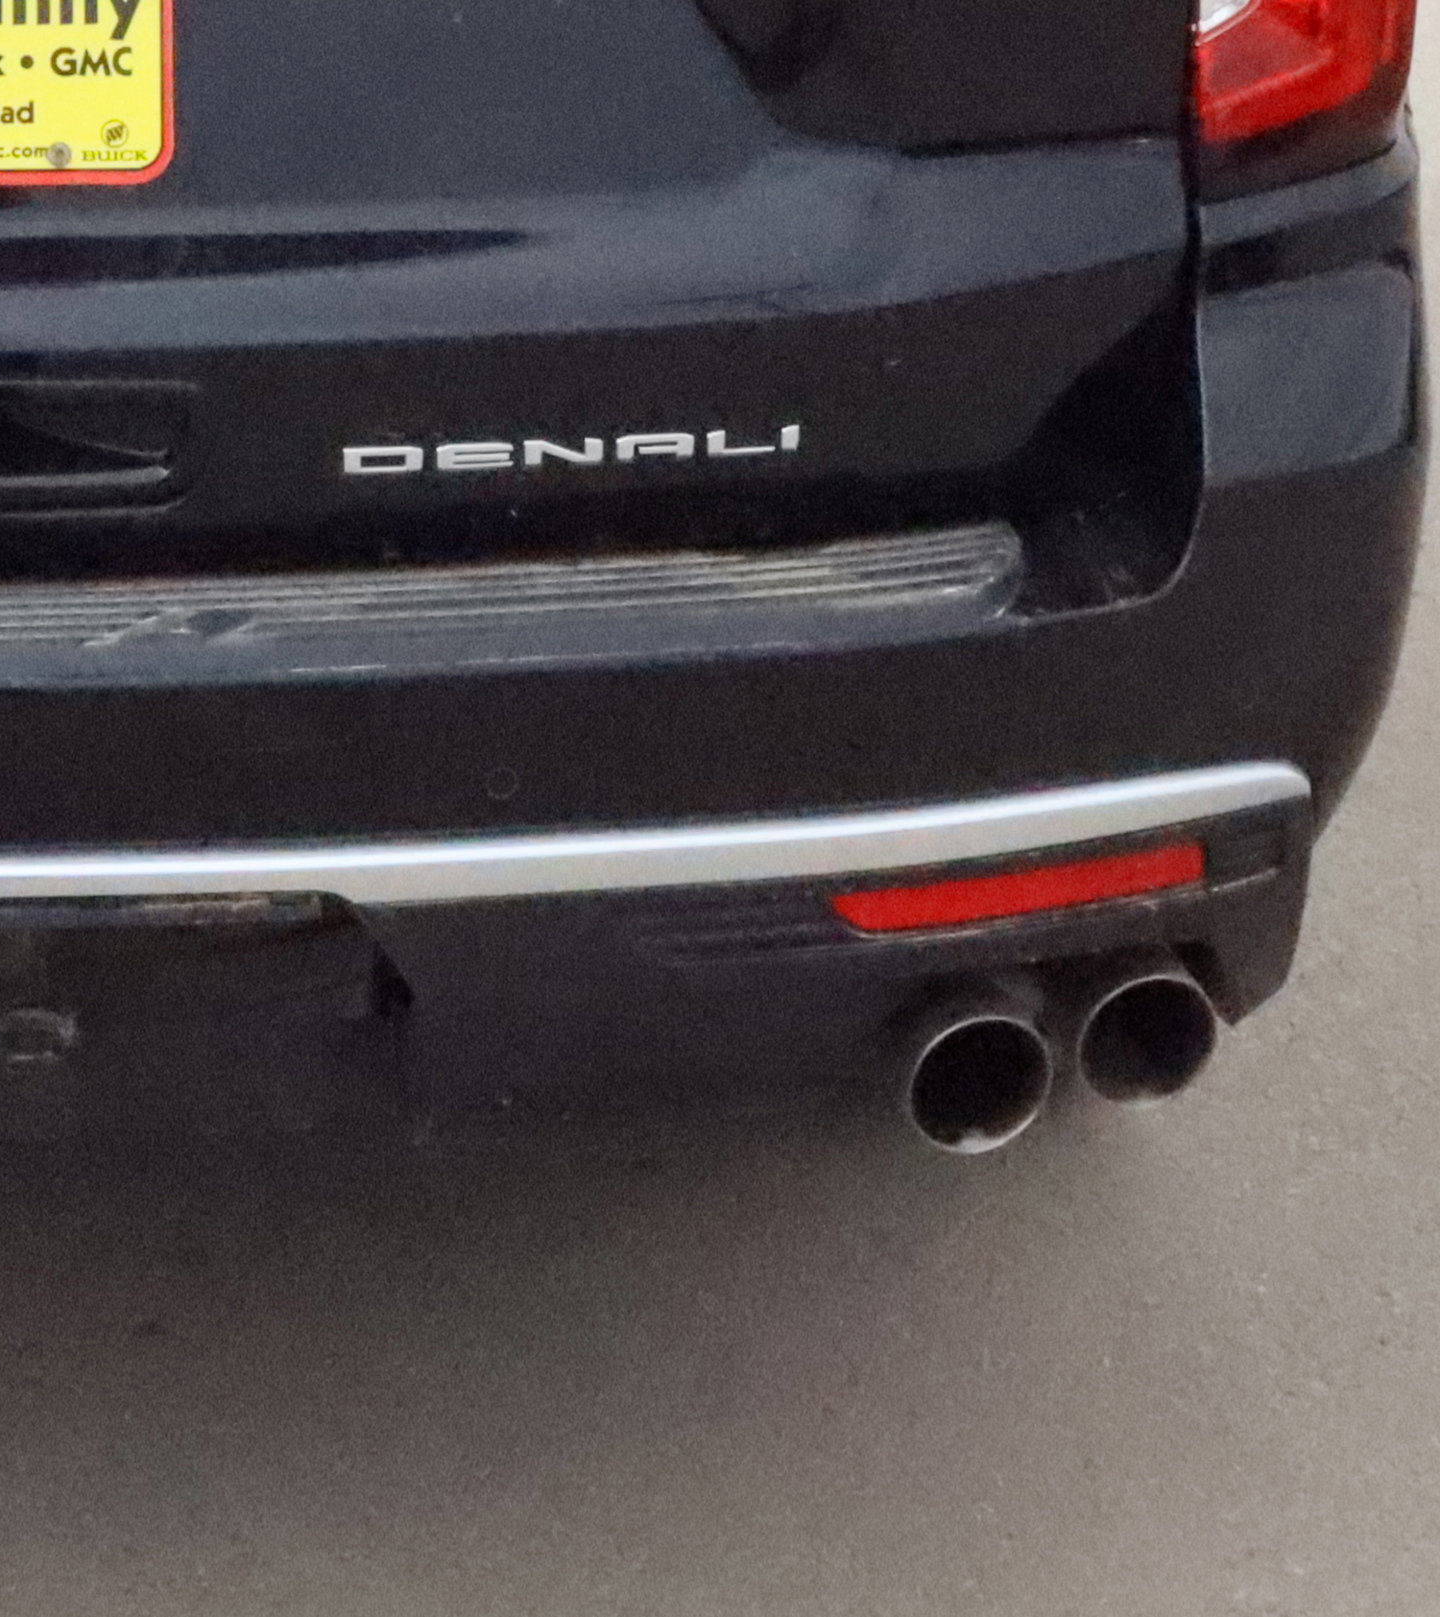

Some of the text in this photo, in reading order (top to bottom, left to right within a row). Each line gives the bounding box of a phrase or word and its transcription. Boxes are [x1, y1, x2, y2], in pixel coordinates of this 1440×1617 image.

[50, 46, 133, 76] GMC
[82, 150, 148, 161] BUICK
[342, 424, 800, 474] DENALI
